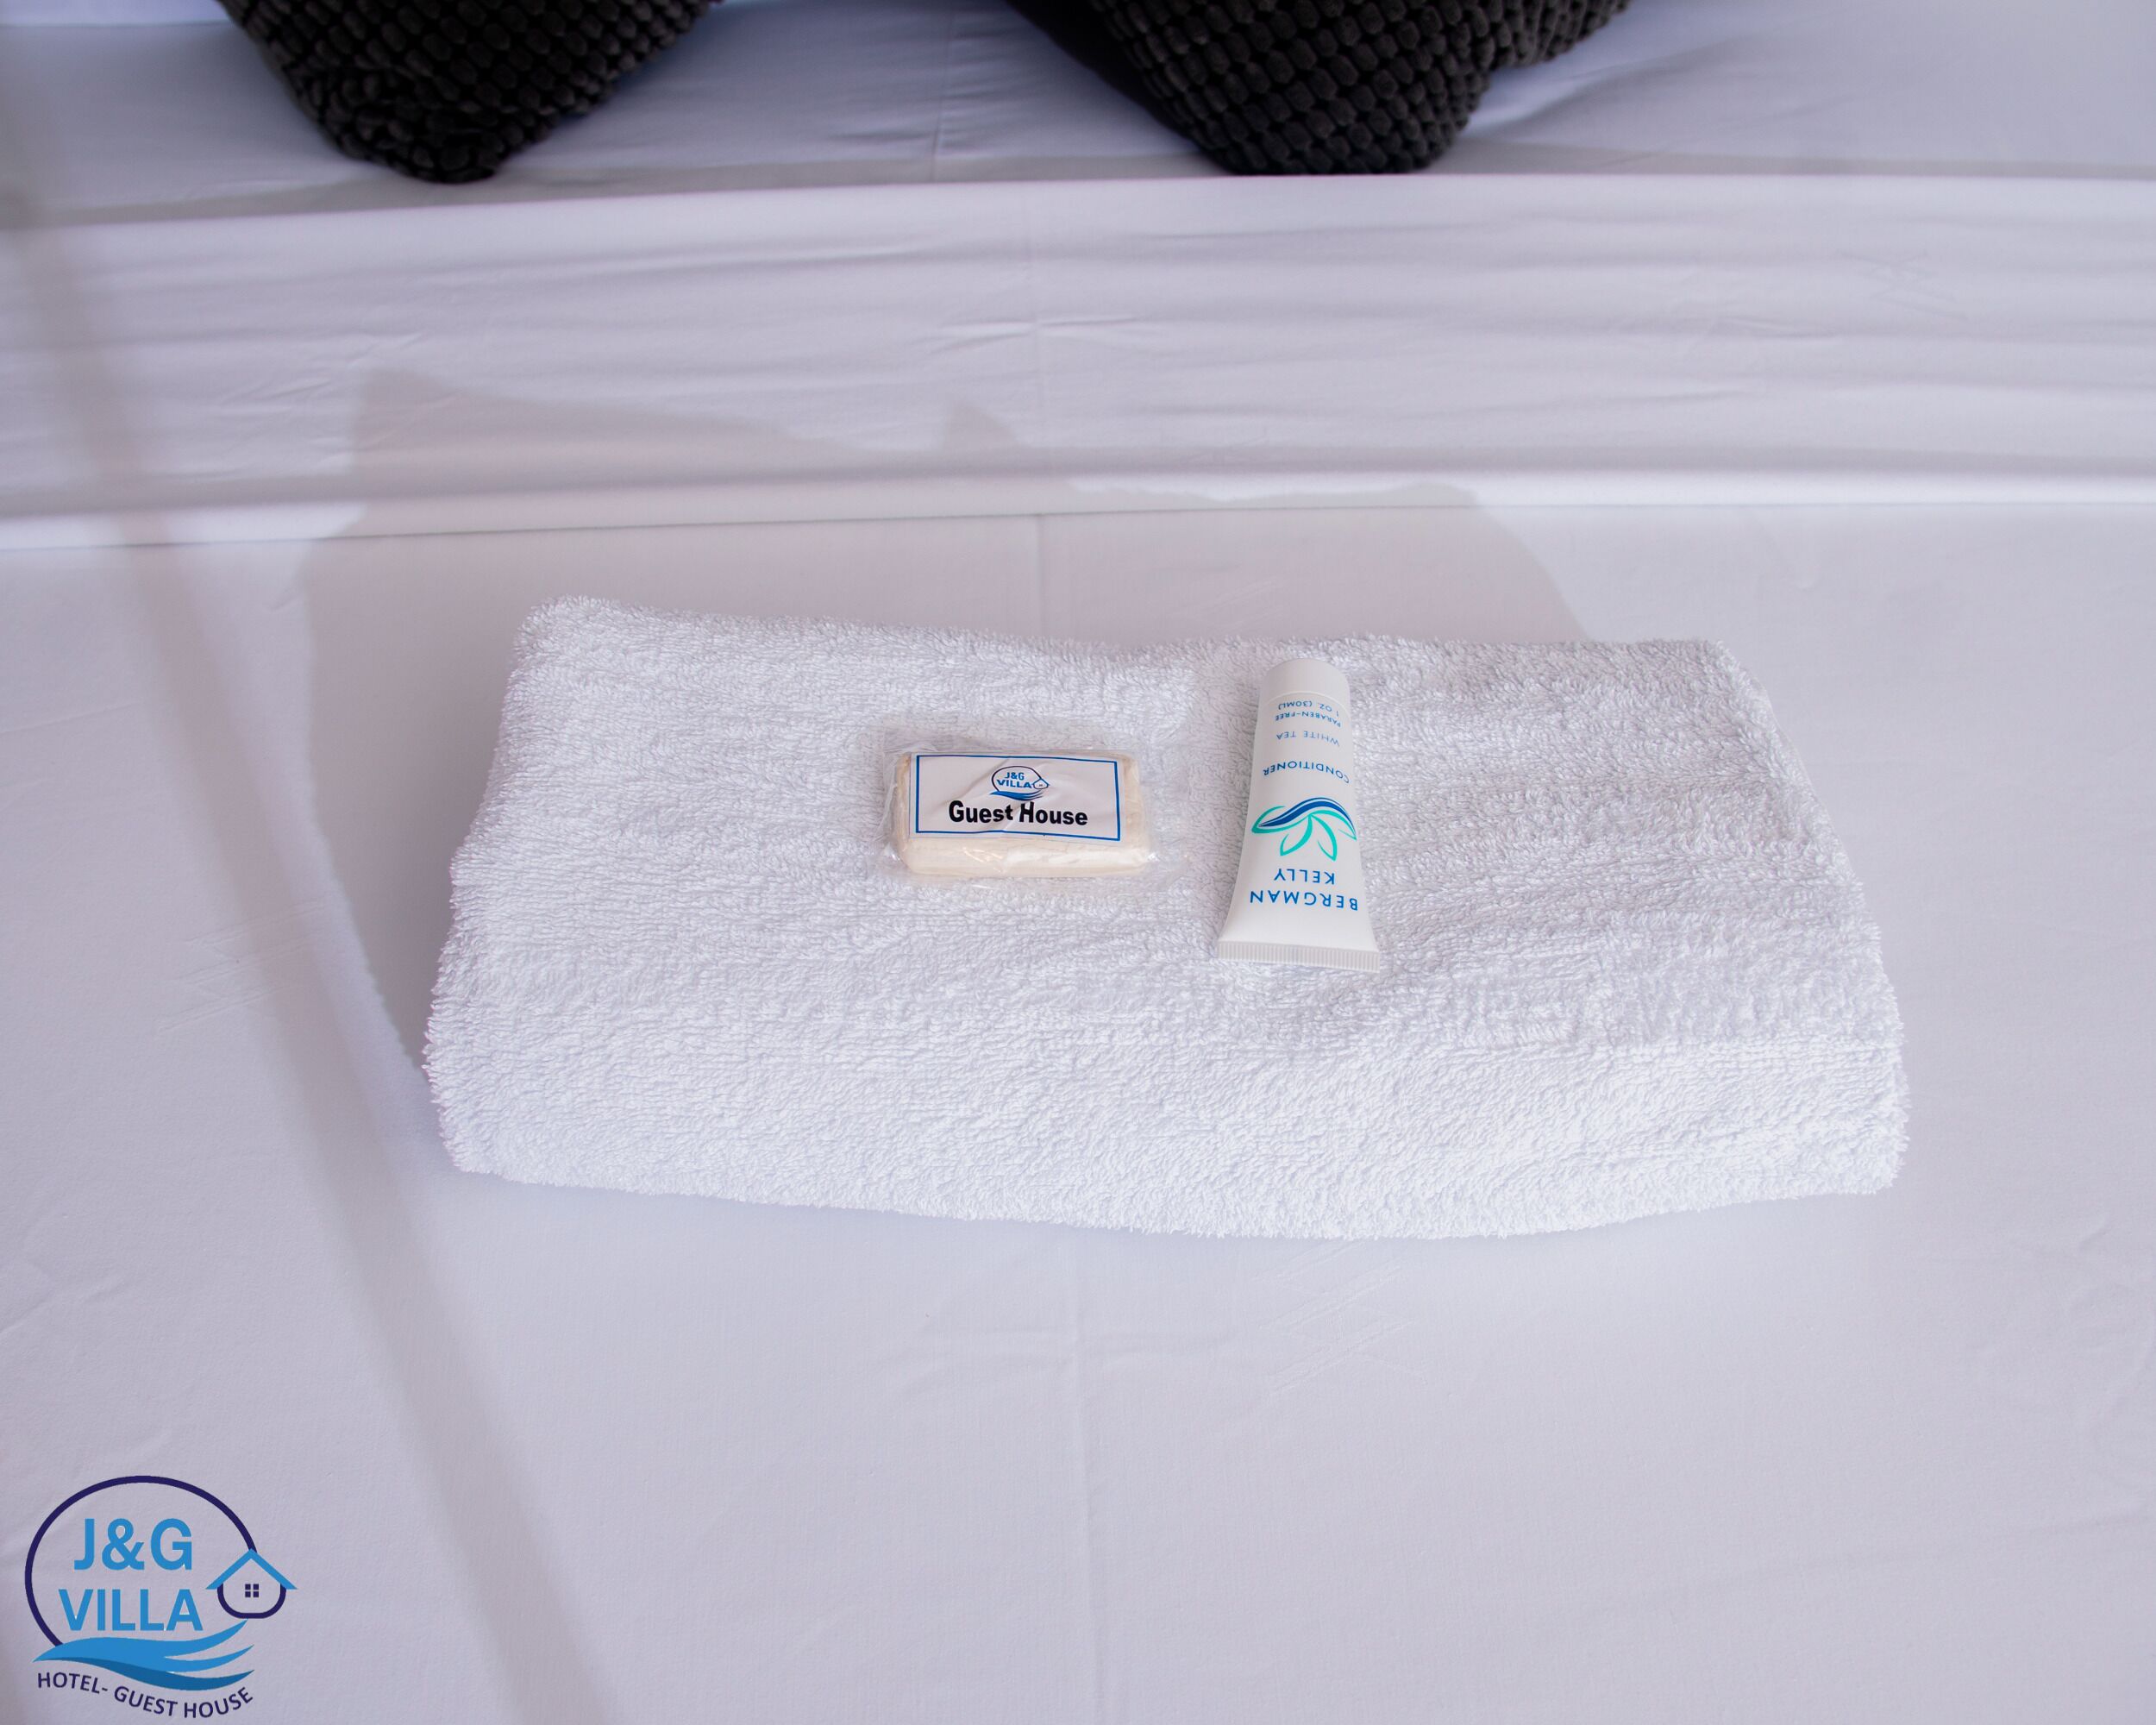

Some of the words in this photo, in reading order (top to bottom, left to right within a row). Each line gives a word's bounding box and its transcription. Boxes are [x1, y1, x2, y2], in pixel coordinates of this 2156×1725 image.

[1278, 700, 1313, 710] (30ML)
[1275, 712, 1342, 727] PARABEN-FREE
[1276, 731, 1297, 740] TEA
[1302, 731, 1340, 747] WHITE
[1005, 772, 1025, 781] J&G
[1263, 761, 1350, 784] CONDITIONER
[996, 779, 1032, 788] VILLA
[949, 800, 1013, 823] Guest
[1019, 801, 1088, 825] House
[1273, 868, 1335, 884] KELLY
[1249, 890, 1358, 911] BERGMAN
